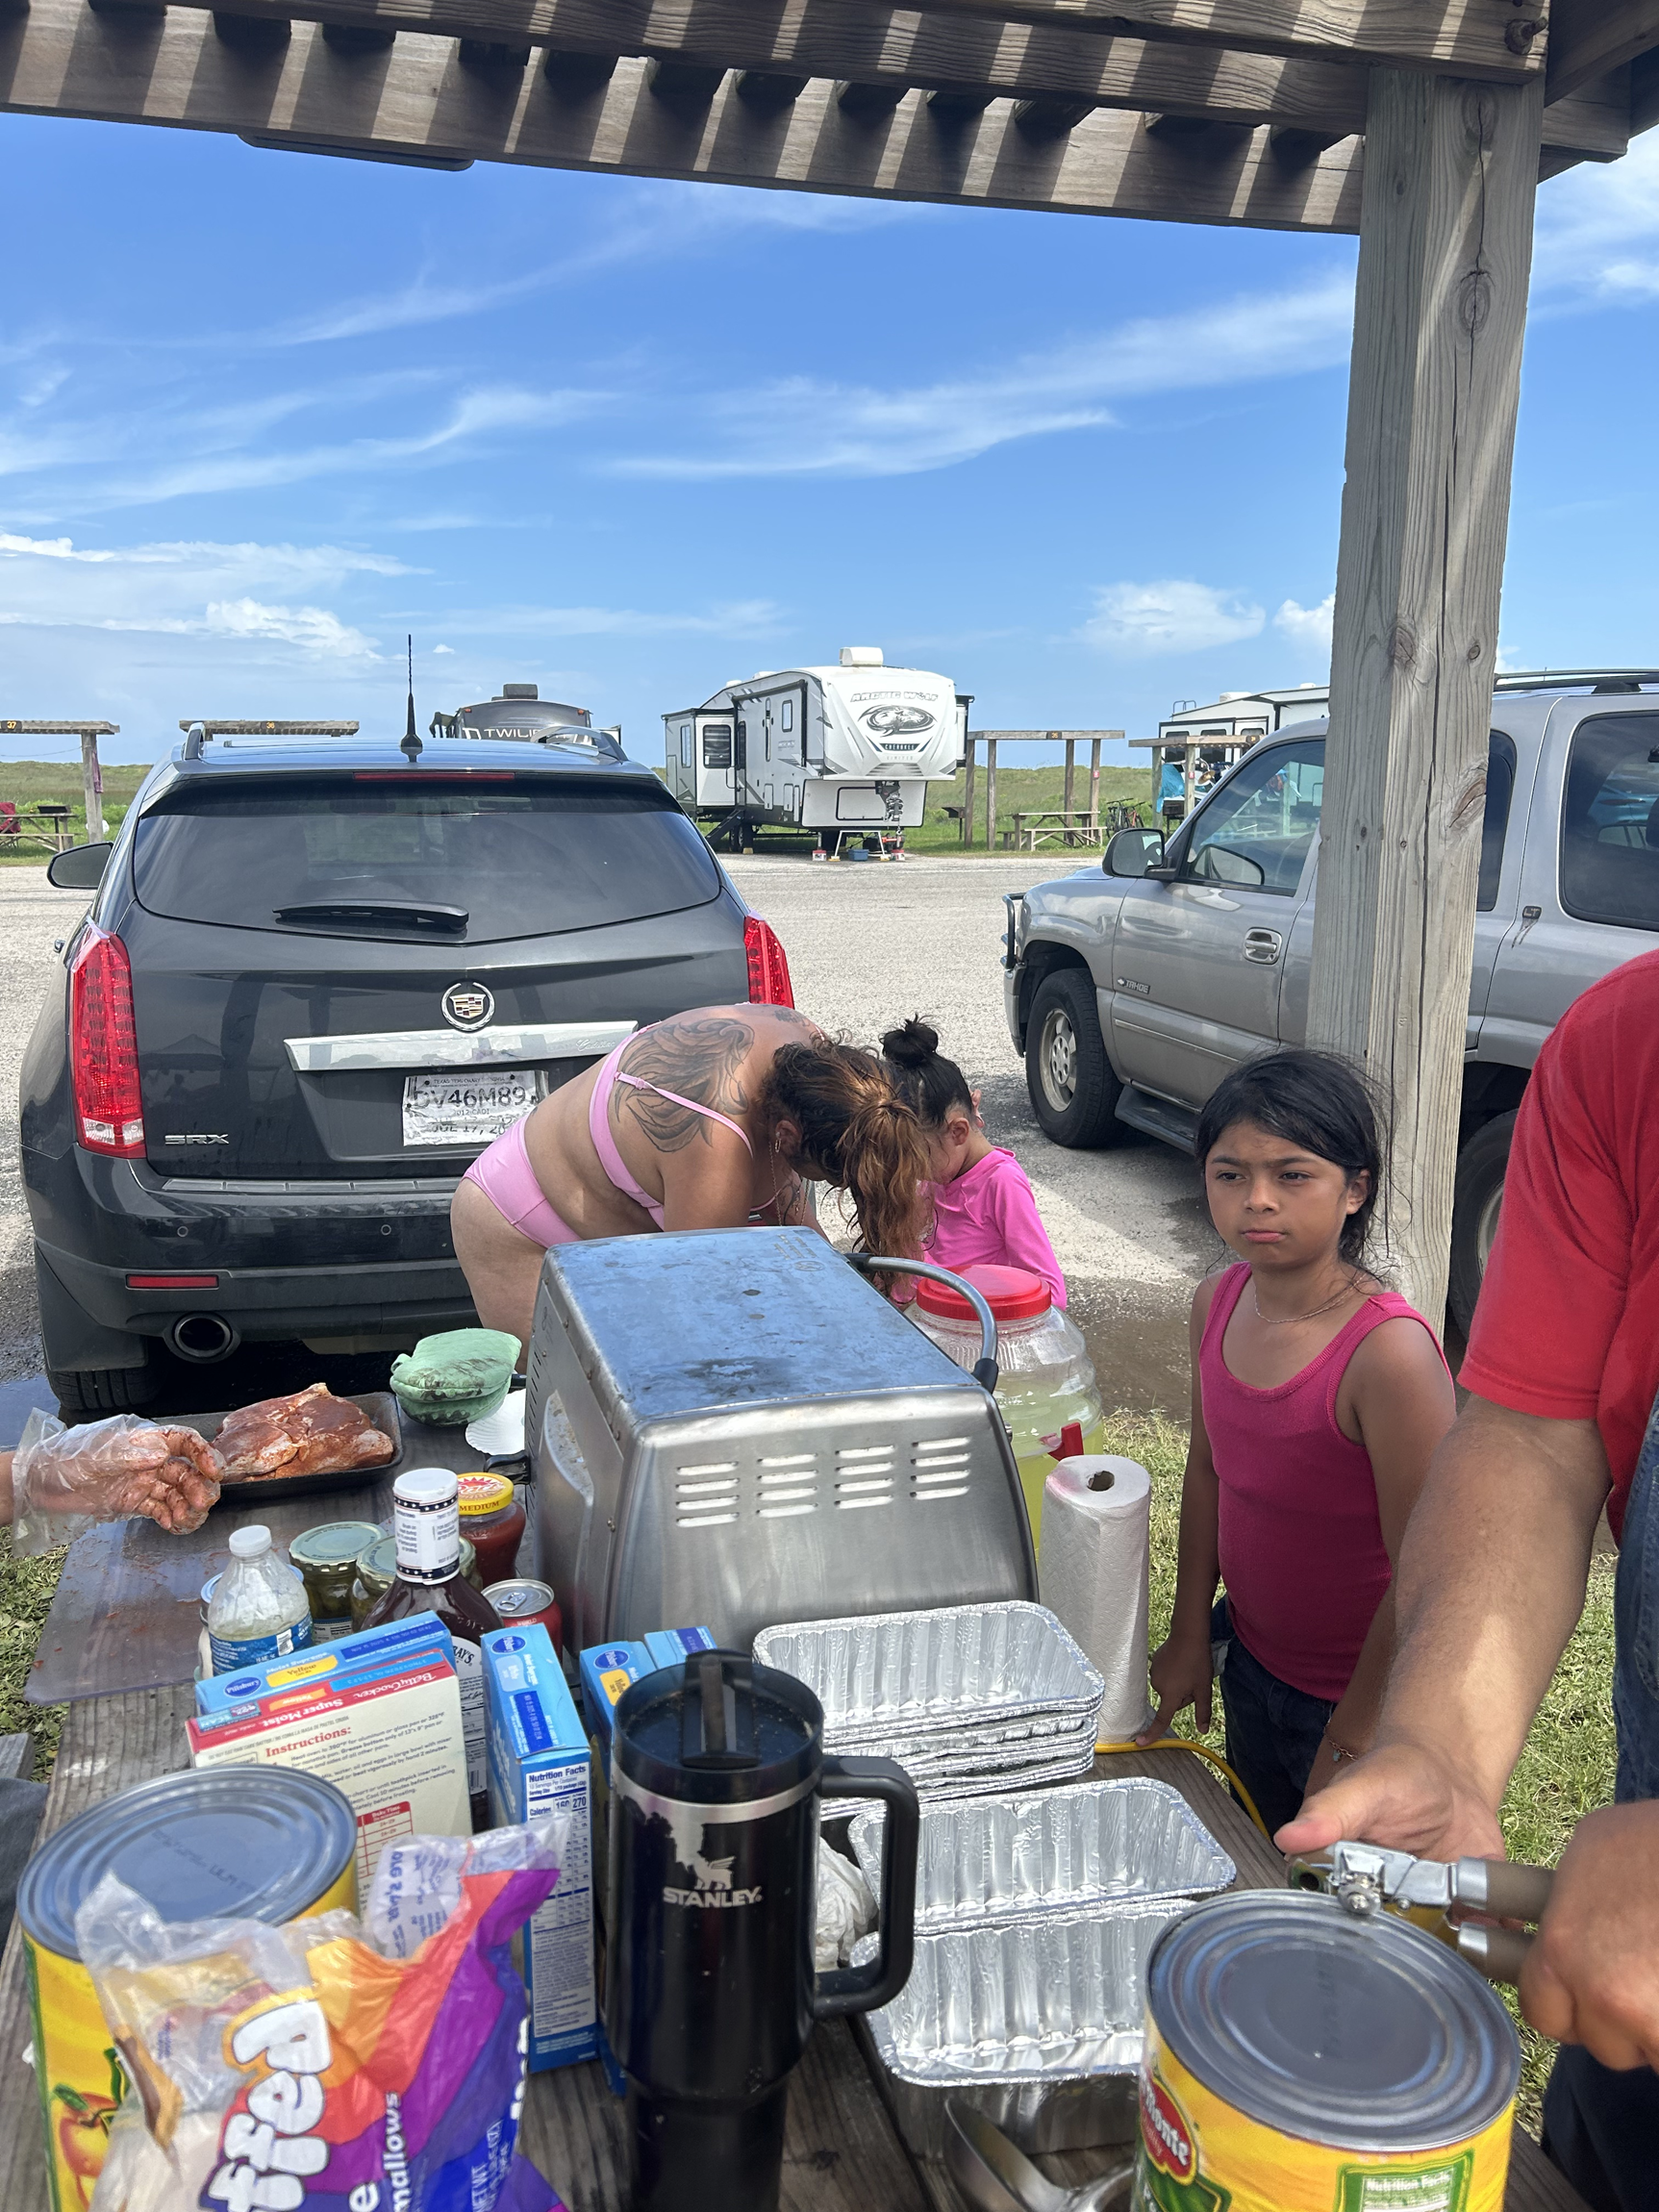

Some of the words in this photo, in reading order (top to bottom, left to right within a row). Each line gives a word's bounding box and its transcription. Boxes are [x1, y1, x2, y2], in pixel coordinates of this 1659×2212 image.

[850, 691, 901, 702] ARCTIC
[7, 720, 16, 730] 37
[484, 728, 548, 739] TWILI
[1523, 908, 1541, 917] LT
[1126, 980, 1149, 993] TAHOE
[164, 1134, 230, 1145] SRX
[460, 1500, 499, 1512] MEDIUM
[226, 1679, 260, 1694] Pillsbury
[400, 1672, 437, 1688] Betty
[353, 1680, 403, 1699] Crocker
[303, 1698, 343, 1713] Super
[262, 1711, 302, 1727] Moist
[265, 1726, 352, 1758] Instructions:
[358, 1731, 385, 1742] aluminum
[363, 1737, 384, 1747] bottom
[353, 1769, 367, 1777] beat
[367, 1760, 397, 1772] vigorously
[405, 1753, 420, 1762] hand
[390, 1773, 416, 1786] toothpick
[529, 1770, 563, 1783] Nutrition
[566, 1765, 586, 1776] Facts
[411, 1777, 429, 1786] before
[373, 1796, 392, 1804] before
[529, 1806, 551, 1817] Calories
[572, 1796, 586, 1808] 270
[663, 1886, 761, 1908] STANLEY
